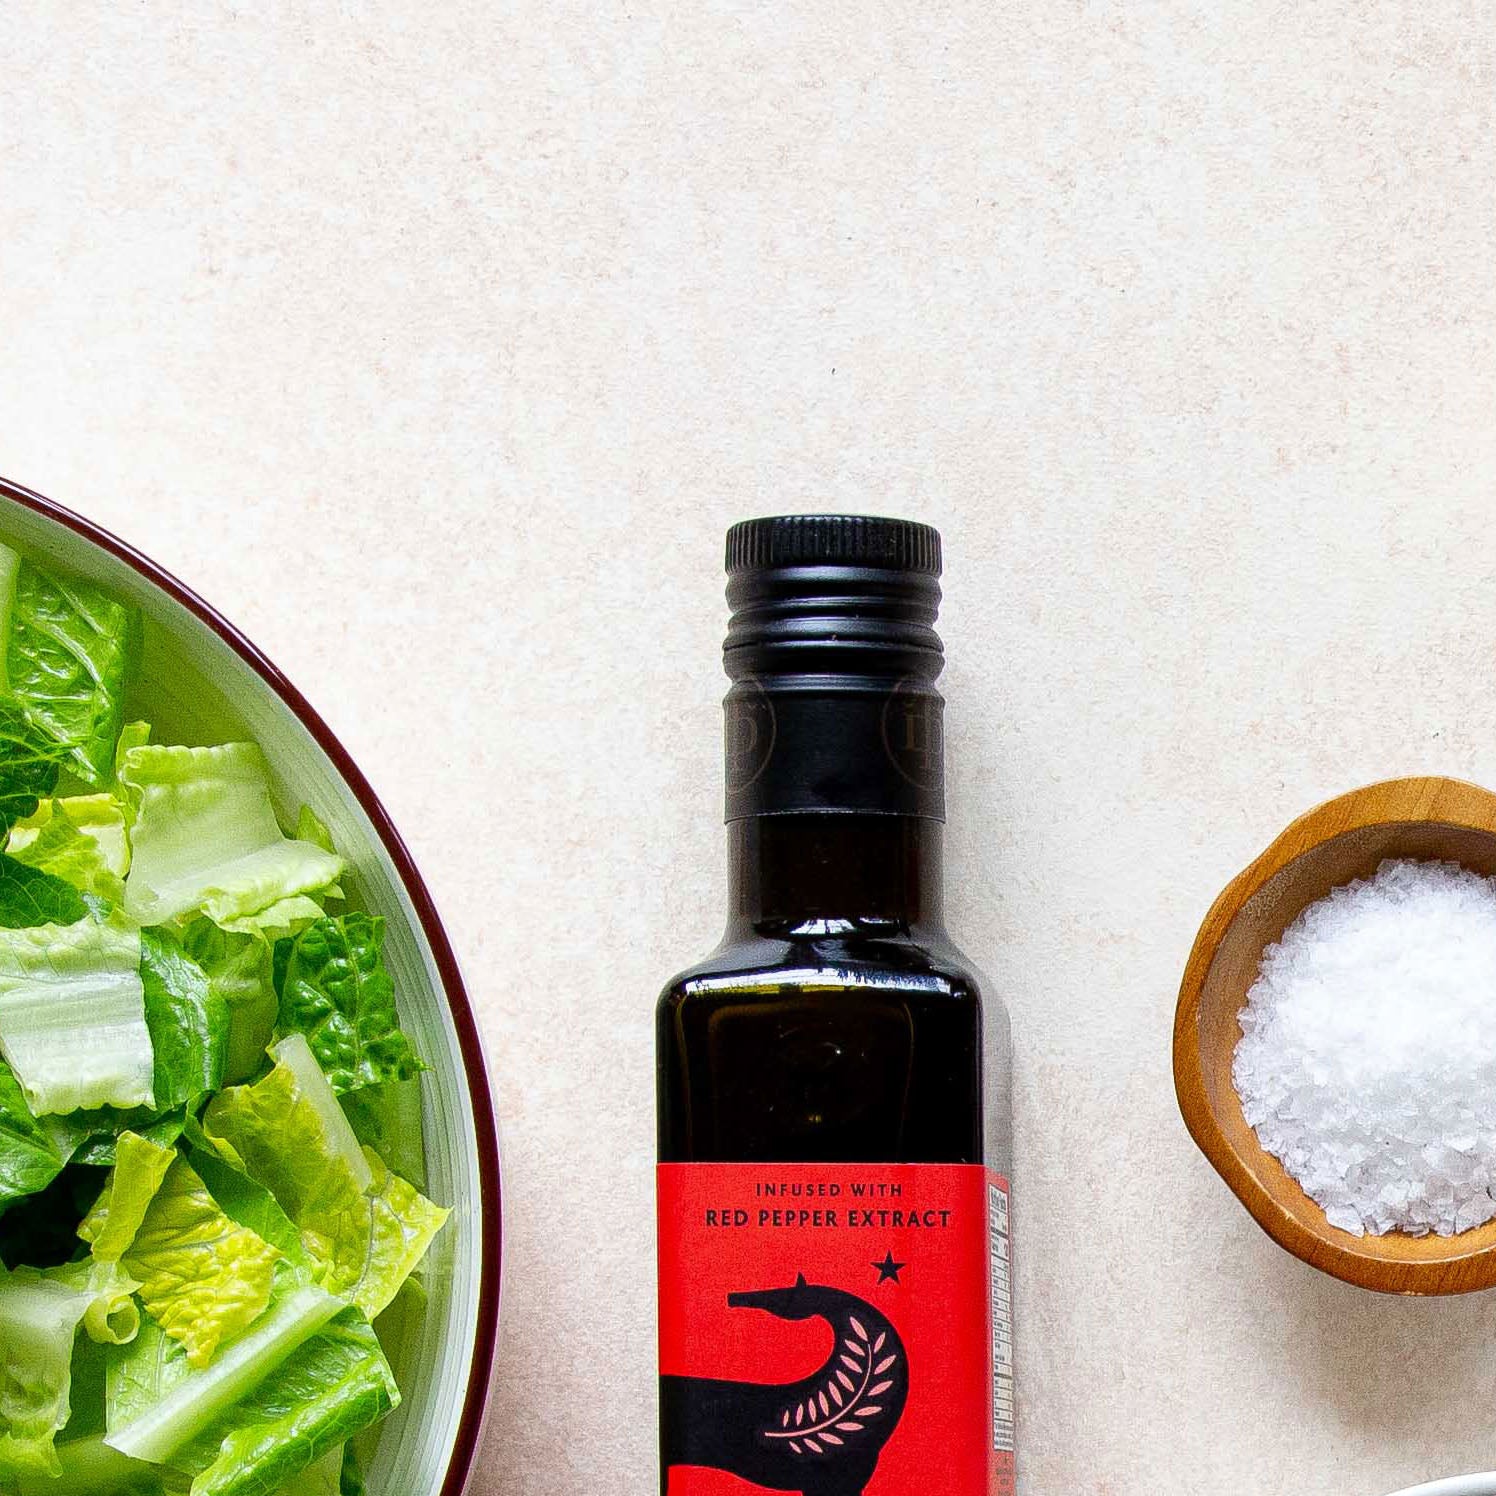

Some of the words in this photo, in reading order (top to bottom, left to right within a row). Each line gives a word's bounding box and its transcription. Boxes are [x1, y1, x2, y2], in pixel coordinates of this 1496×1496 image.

[756, 1183, 841, 1197] INFUSED
[851, 1184, 902, 1197] WITH
[706, 1210, 749, 1227] RED
[758, 1210, 838, 1227] PEPPER
[848, 1210, 951, 1227] EXTRACT
